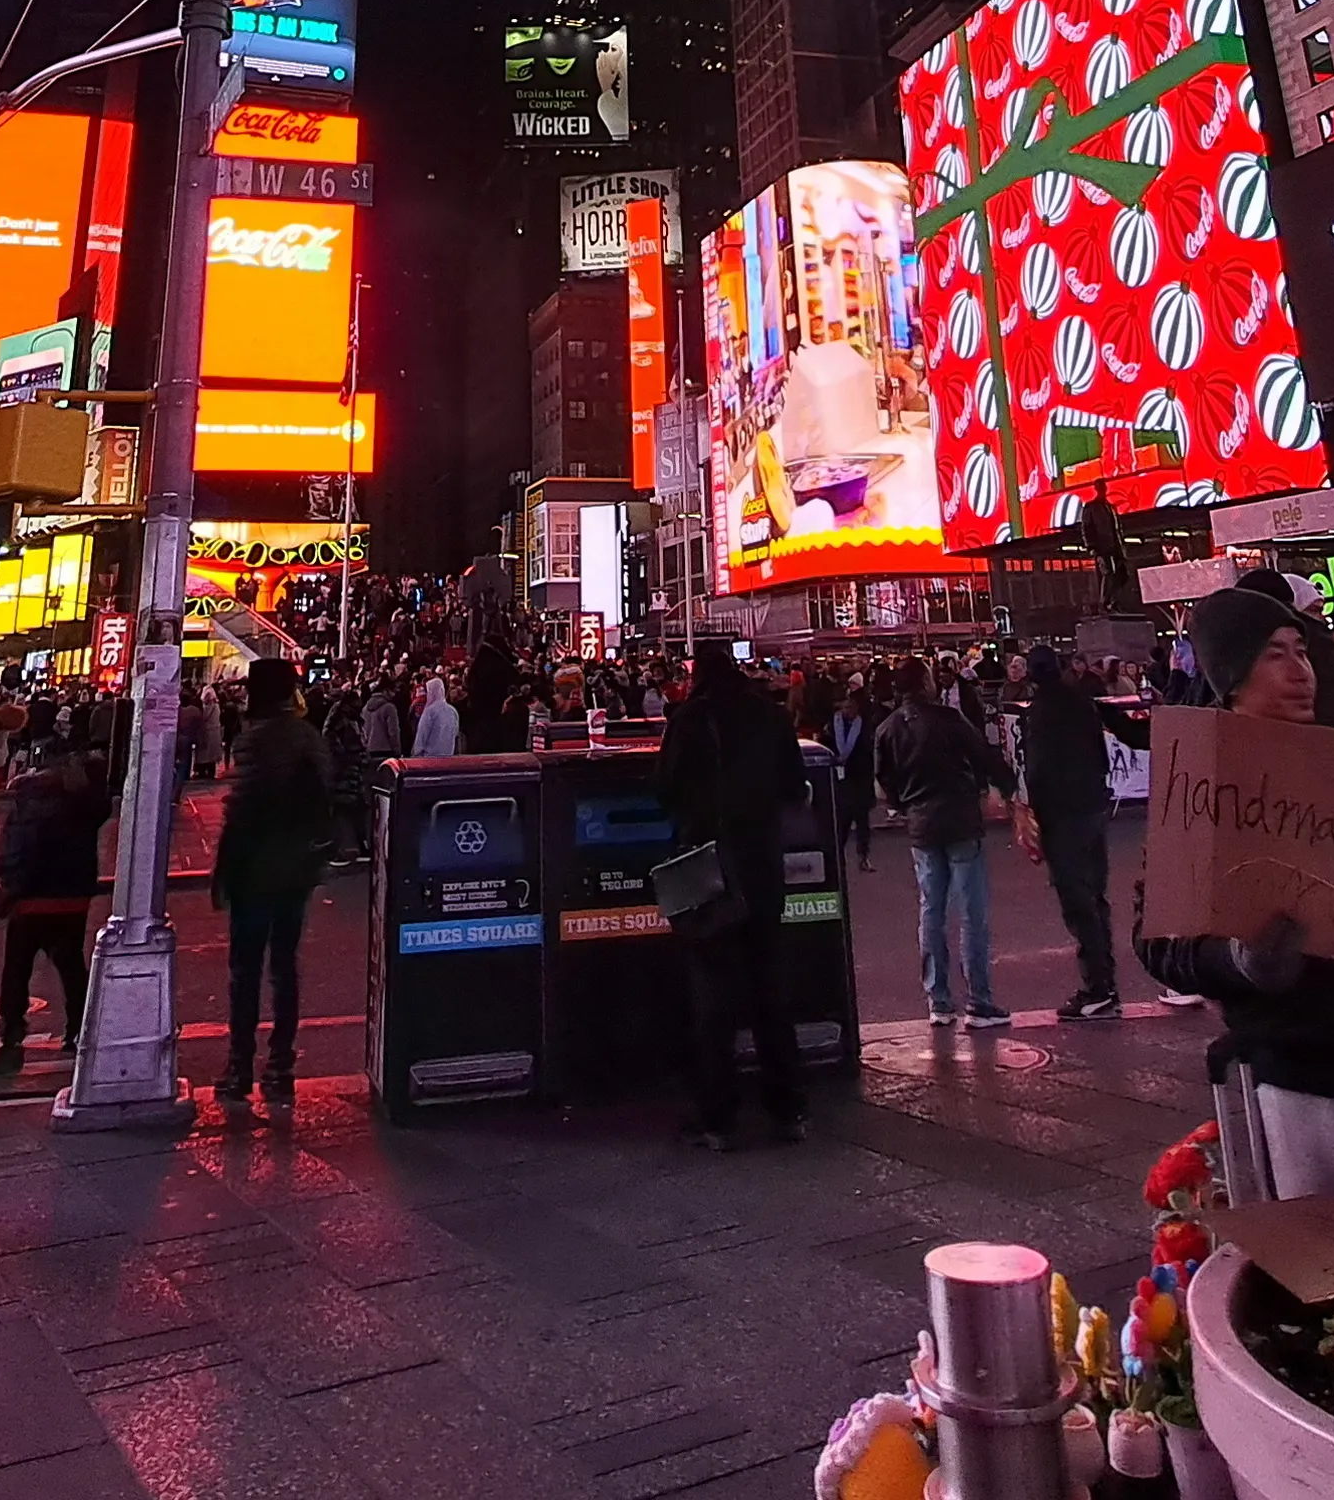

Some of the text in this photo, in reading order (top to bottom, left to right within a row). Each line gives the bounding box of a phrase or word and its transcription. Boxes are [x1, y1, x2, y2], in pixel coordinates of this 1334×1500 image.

[528, 100, 577, 110] Courage.
[555, 88, 589, 99] Heart.
[223, 106, 327, 144] Coca-Cola
[259, 164, 369, 198] W 46 St
[571, 176, 670, 209] LITTLE SHOP
[207, 218, 341, 272] Coca-Cola
[99, 616, 127, 667] tkts
[580, 613, 600, 661] tkts
[563, 914, 622, 934] TIMES
[784, 898, 839, 919] QUARE
[403, 922, 538, 947] TIMES SQUARE
